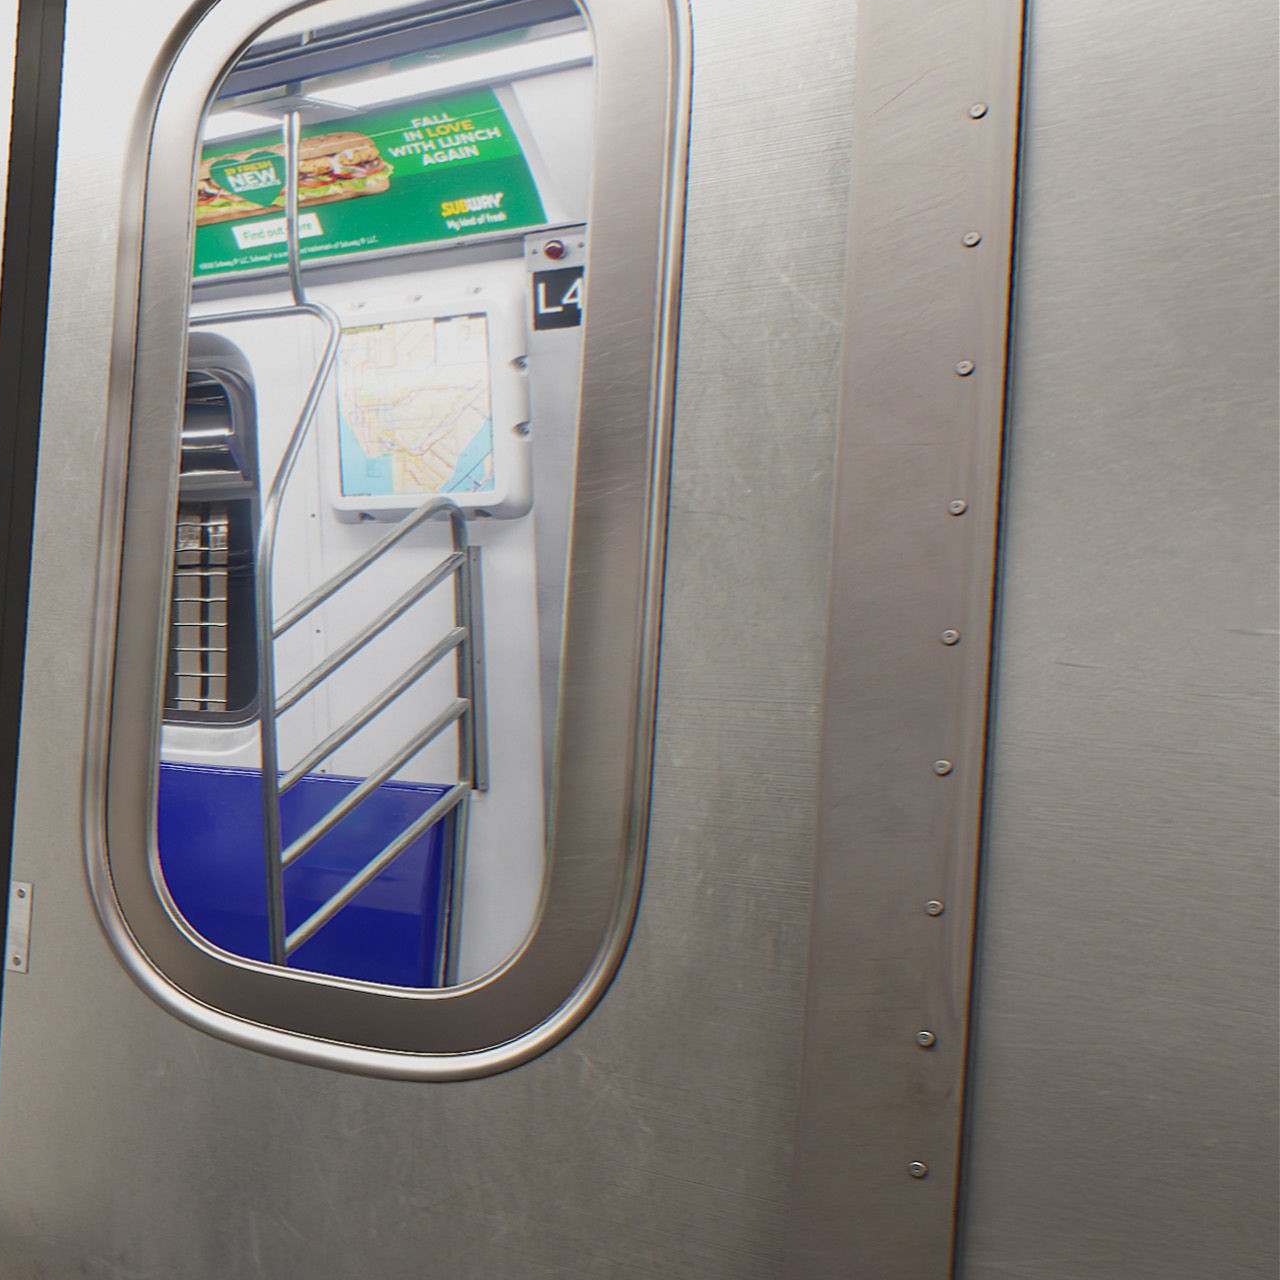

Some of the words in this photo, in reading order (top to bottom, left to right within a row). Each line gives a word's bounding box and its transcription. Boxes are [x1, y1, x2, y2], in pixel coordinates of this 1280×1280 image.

[403, 130, 424, 142] IN
[425, 120, 475, 137] LOVE
[411, 112, 456, 128] FALL
[387, 139, 437, 158] WITH
[437, 126, 502, 149] LUNCH
[422, 144, 480, 167] AGAIN
[226, 167, 277, 188] NEW
[441, 192, 504, 217] SUBWAY
[242, 228, 265, 241] Find
[538, 277, 584, 314] L4
